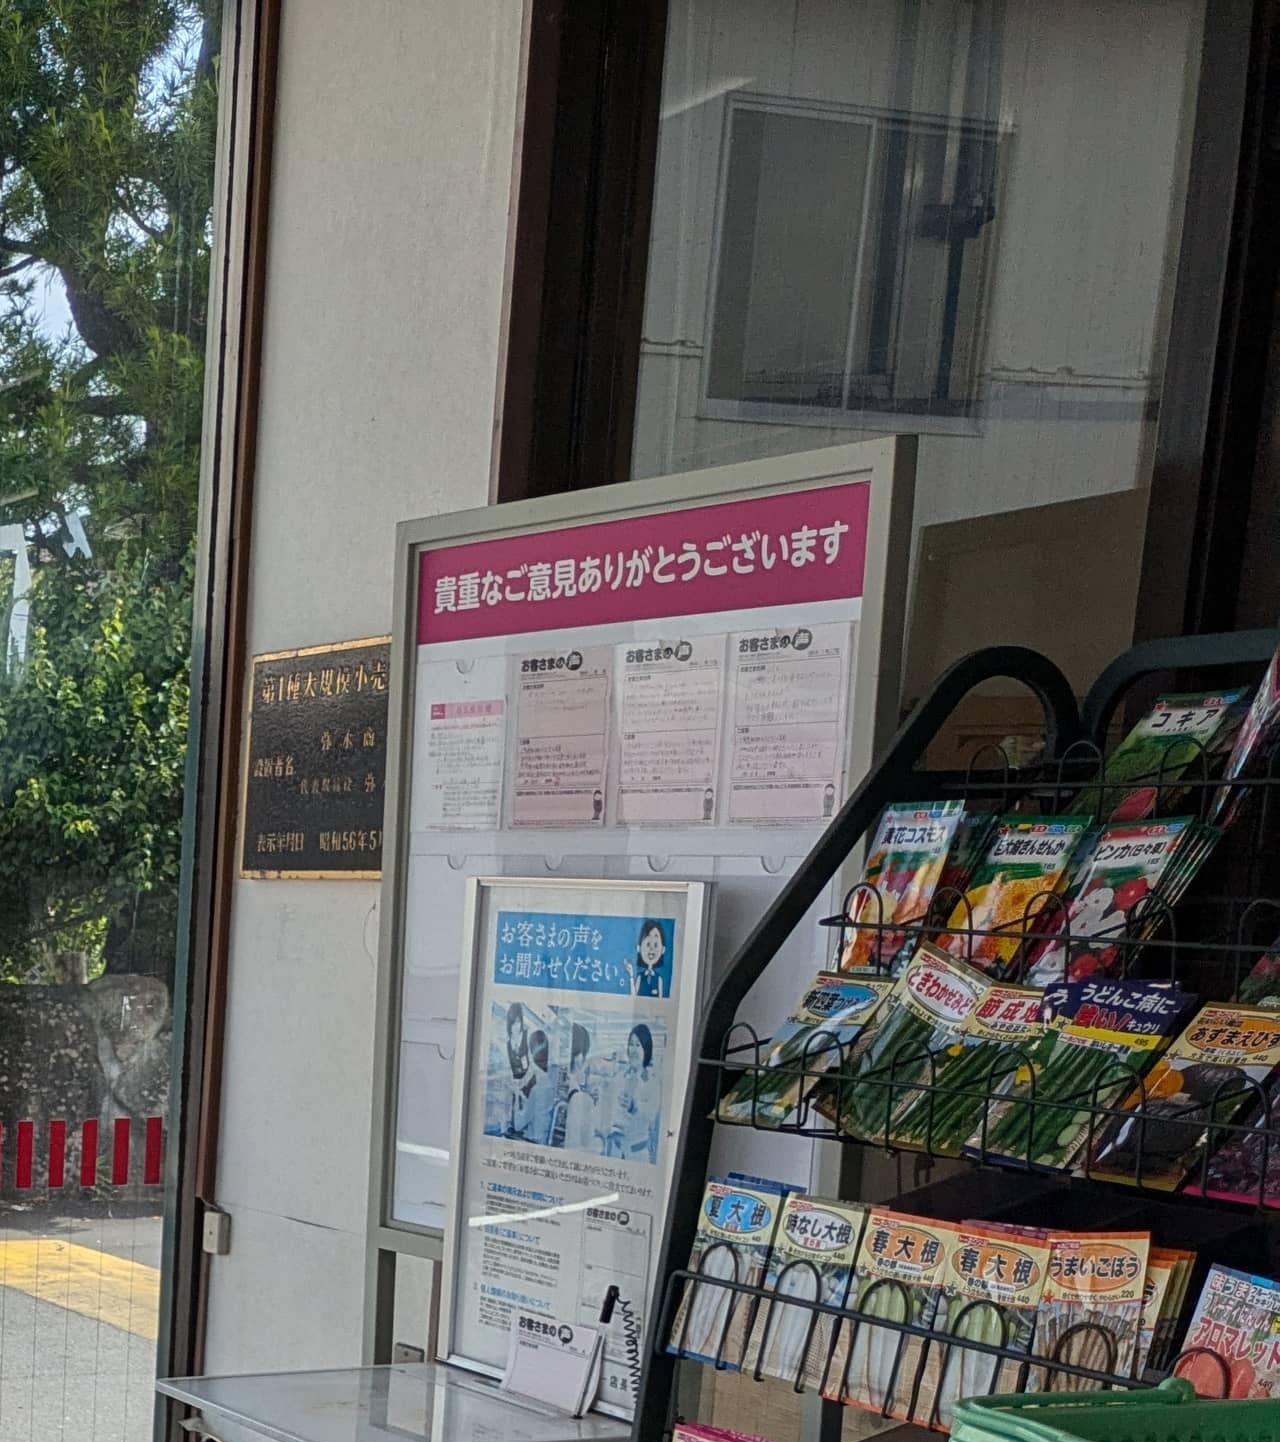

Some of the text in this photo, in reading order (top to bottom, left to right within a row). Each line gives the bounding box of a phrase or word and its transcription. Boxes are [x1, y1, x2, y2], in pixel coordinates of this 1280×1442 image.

[432, 519, 849, 615] 貴重なご意見ありがとうございます
[1151, 708, 1220, 728] コキア
[881, 824, 947, 845] 黄花コスモス
[500, 919, 604, 951] お客さまの声を
[498, 951, 626, 988] お聞かせください。
[975, 997, 1041, 1023] 節成地
[1080, 983, 1175, 1014] うどんこ病に
[1125, 1019, 1161, 1034] キュウリ
[1189, 1026, 1280, 1048] あずまえびす
[709, 1195, 768, 1227] 夏大根
[786, 1213, 852, 1245] 時なし大根
[872, 1230, 940, 1266] 春大根
[960, 1247, 1034, 1288] 春大根
[1049, 1255, 1139, 1279] うまいごぼう
[1120, 1289, 1135, 1299] 220
